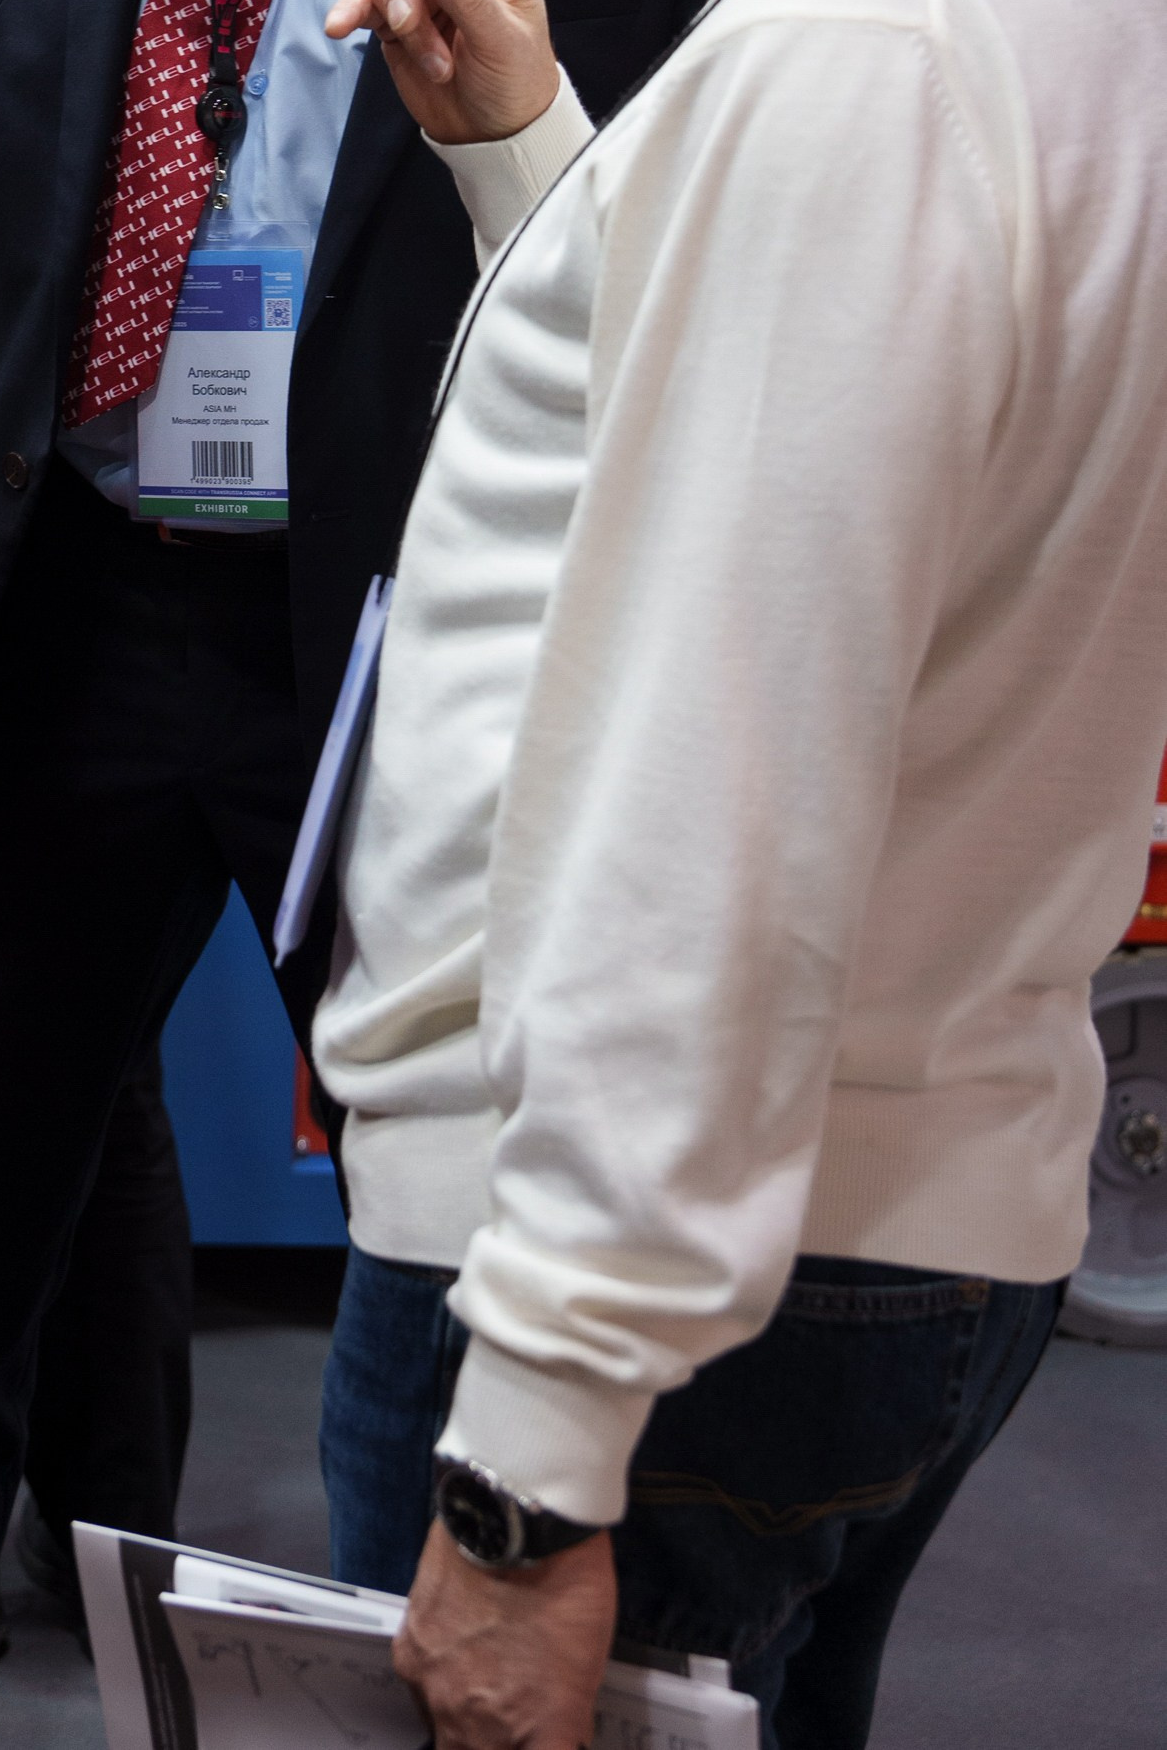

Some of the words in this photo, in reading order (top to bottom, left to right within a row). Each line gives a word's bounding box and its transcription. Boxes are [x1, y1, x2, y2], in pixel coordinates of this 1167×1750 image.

[135, 27, 184, 56] HELI
[148, 59, 198, 87] HELI
[125, 90, 170, 119] HELI
[137, 121, 183, 150] HELI
[174, 130, 206, 150] HE
[115, 153, 156, 182] HELI
[150, 152, 197, 182] HELI
[188, 161, 217, 181] HE
[127, 184, 169, 214] HELI
[163, 183, 210, 213] HELI
[107, 216, 146, 246] HELI
[139, 216, 183, 246] HELI
[117, 248, 159, 278] HELI
[152, 253, 186, 277] HEL
[94, 280, 135, 310] HELI
[130, 280, 173, 310] HELI
[105, 312, 149, 342] HELI
[143, 318, 172, 342] HE
[85, 344, 126, 374] HELI
[118, 344, 163, 374] HELI
[187, 367, 251, 381] Александр
[95, 376, 139, 406] HELI
[192, 384, 247, 395] Бобкович
[171, 416, 210, 425] Менеджер
[212, 417, 239, 426] отдела
[240, 418, 270, 426] продаж
[203, 405, 221, 413] ASIA
[195, 503, 249, 514] EXHIBITOR
